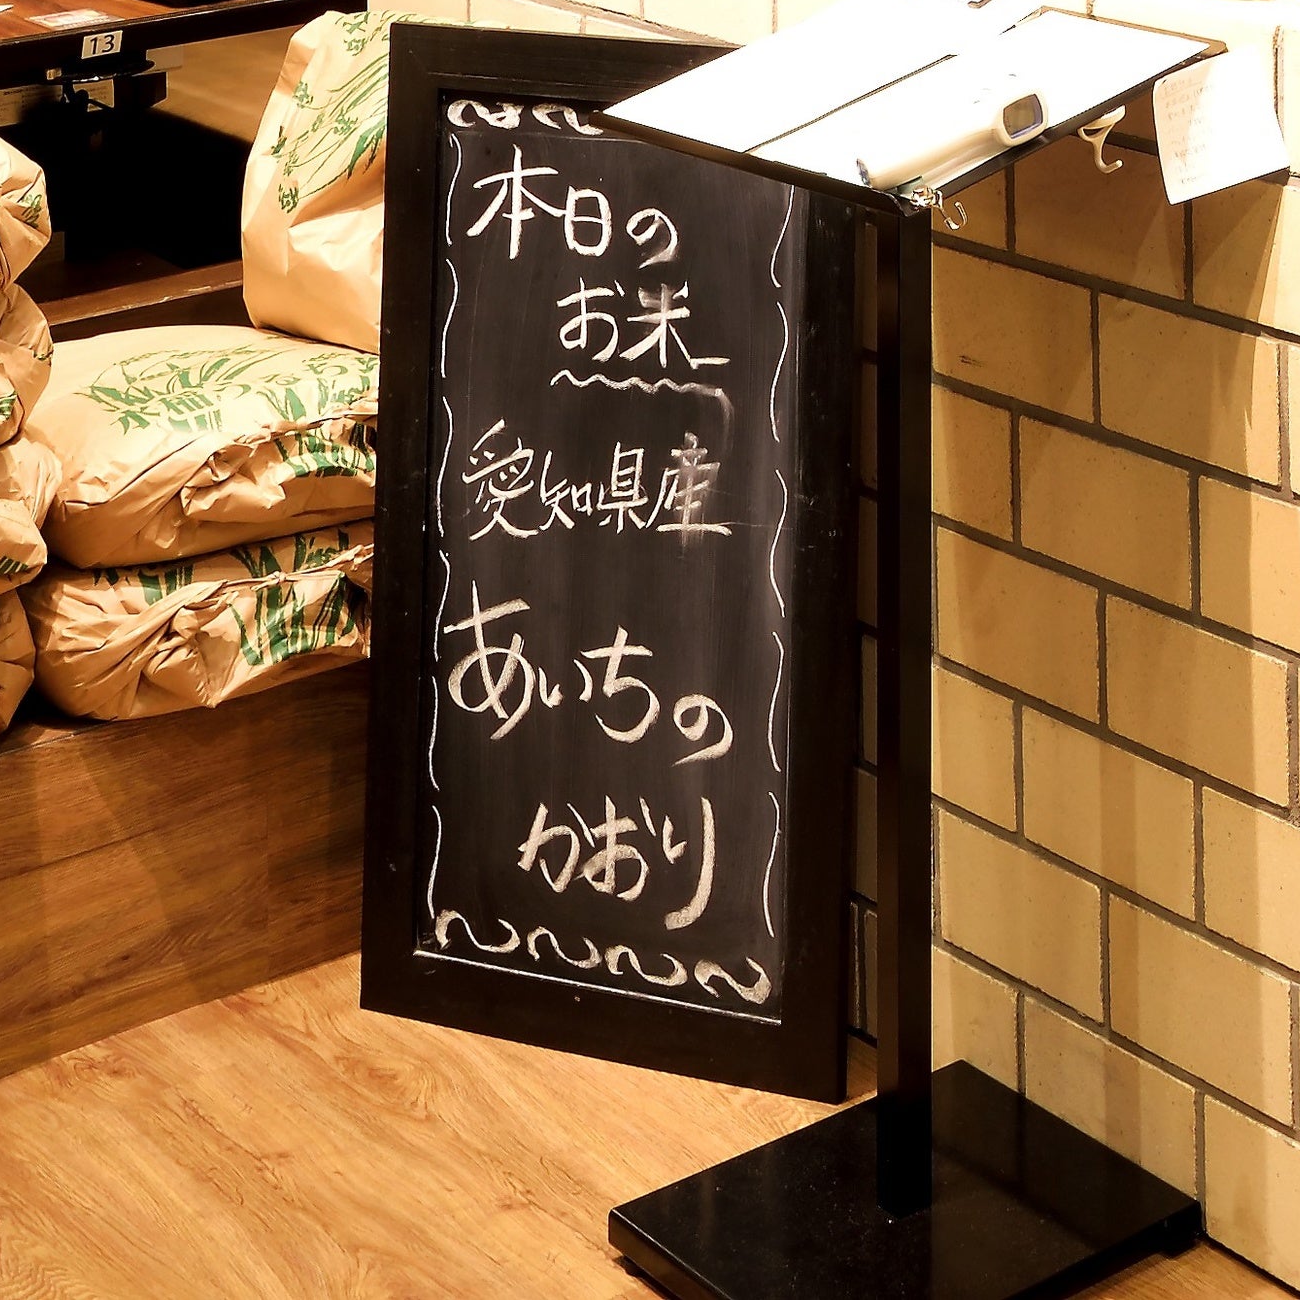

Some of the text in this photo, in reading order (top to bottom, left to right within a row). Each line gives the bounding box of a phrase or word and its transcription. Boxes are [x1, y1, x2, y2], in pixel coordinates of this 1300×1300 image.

[90, 34, 115, 55] 13
[467, 143, 681, 268] 本日の
[555, 282, 728, 369] お米
[460, 417, 733, 543] 愛知県産
[443, 580, 734, 765] あいちの
[517, 795, 719, 930] かおり
